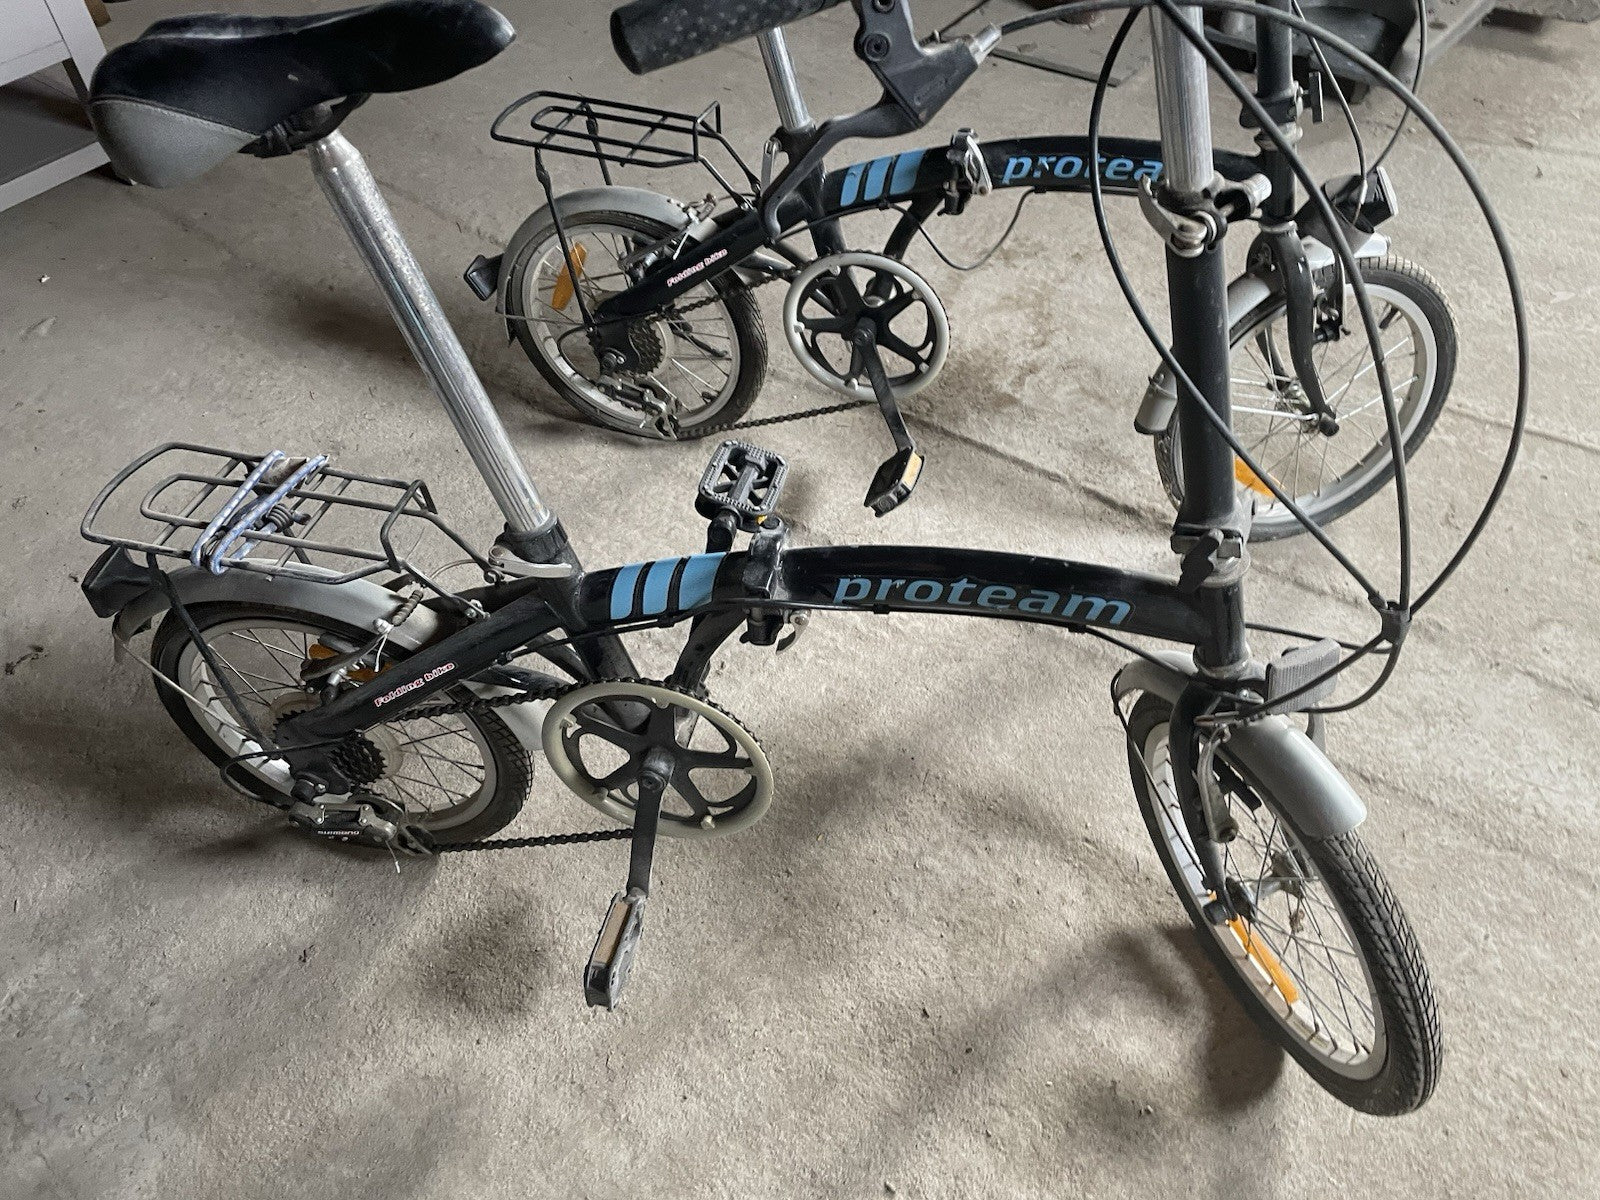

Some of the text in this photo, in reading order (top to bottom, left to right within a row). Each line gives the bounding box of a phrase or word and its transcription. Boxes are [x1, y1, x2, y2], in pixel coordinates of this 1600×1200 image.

[1001, 155, 1164, 185] proea
[832, 576, 1132, 625] proteam
[374, 662, 455, 708] Folding bike
